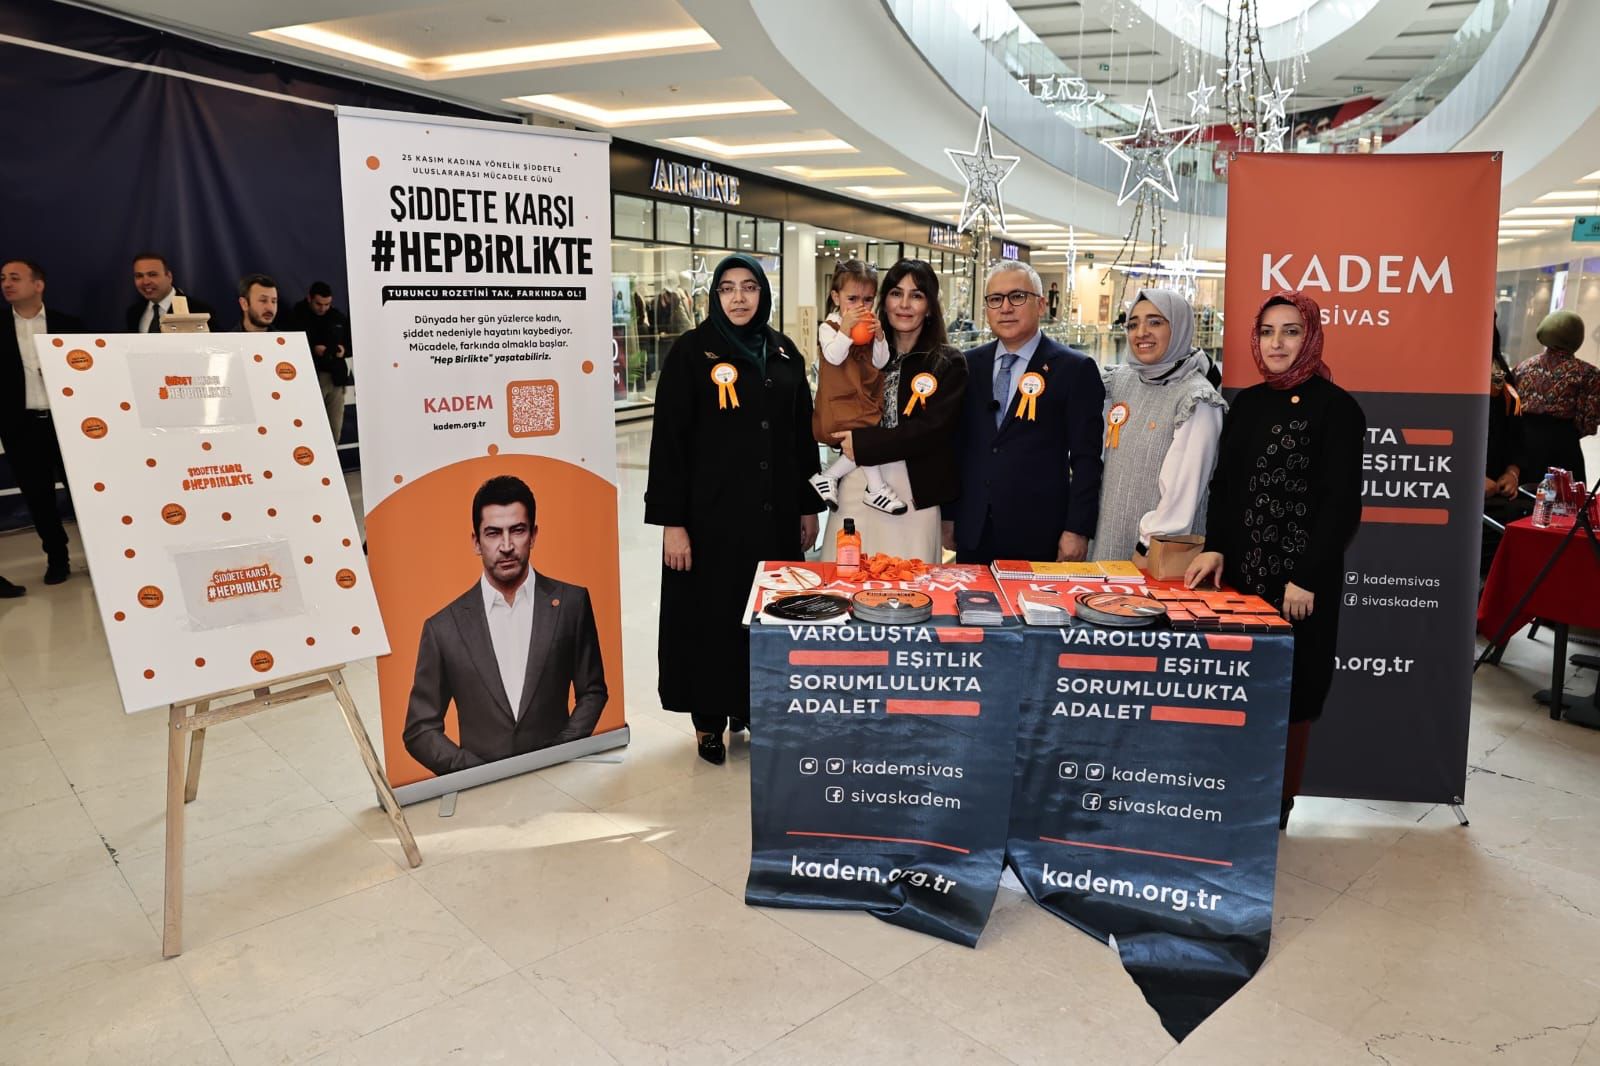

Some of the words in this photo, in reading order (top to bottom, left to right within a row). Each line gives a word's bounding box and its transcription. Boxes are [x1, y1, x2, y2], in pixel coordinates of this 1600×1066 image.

[402, 153, 412, 161] 25
[416, 155, 444, 163] KASIM
[447, 157, 481, 166] KADINA
[412, 167, 480, 178] ULUSLARARASI
[483, 171, 528, 181] MÜCADELE
[530, 175, 553, 184] GÜNÜ
[505, 191, 574, 230] KARŞI
[1261, 253, 1454, 294] KADEM
[388, 289, 439, 298] TURUNCU
[442, 287, 488, 298] ROZETİNİ
[492, 289, 513, 299] TAK,
[516, 290, 563, 298] FARKINDA
[567, 290, 582, 298] OL!
[414, 315, 458, 326] Dünyada
[460, 314, 476, 324] her
[477, 314, 495, 325] gün
[497, 314, 534, 325] yüzlerce
[535, 314, 562, 323] kadın,
[1320, 304, 1390, 326] SİVAS
[402, 329, 434, 340] şiddet
[436, 328, 481, 339] nedeniyle
[483, 327, 521, 338] hayatını
[522, 327, 573, 338] kaybediyor.
[409, 343, 458, 352] Mücadele,
[460, 341, 500, 350] farkında
[501, 340, 538, 349] olmakla
[539, 340, 569, 350] başlar.
[430, 355, 453, 365] "Hep
[455, 353, 494, 364] Birlikte"
[494, 352, 552, 364] yaşatabiliriz.
[423, 394, 493, 414] KADEM
[433, 420, 486, 431] kadem.org.tr
[1363, 573, 1440, 588] kademsivas
[1362, 595, 1439, 609] sivaskadem
[788, 625, 932, 643] VAROLUŞTA
[1059, 628, 1202, 649] VAROLUŞTA
[789, 674, 982, 692] SORUMLULUKTA
[1056, 677, 1248, 702] SORUMLULUKTA
[788, 698, 880, 714] ADALET
[1052, 702, 1145, 720] ADALET
[852, 759, 963, 779] kademsivas
[1112, 765, 1225, 790] kademsivas
[851, 789, 960, 809] sivaskadem
[1109, 797, 1222, 822] sivaskadem
[791, 855, 956, 895] kadem.org.tr
[1041, 863, 1222, 911] kadem.org.tr
